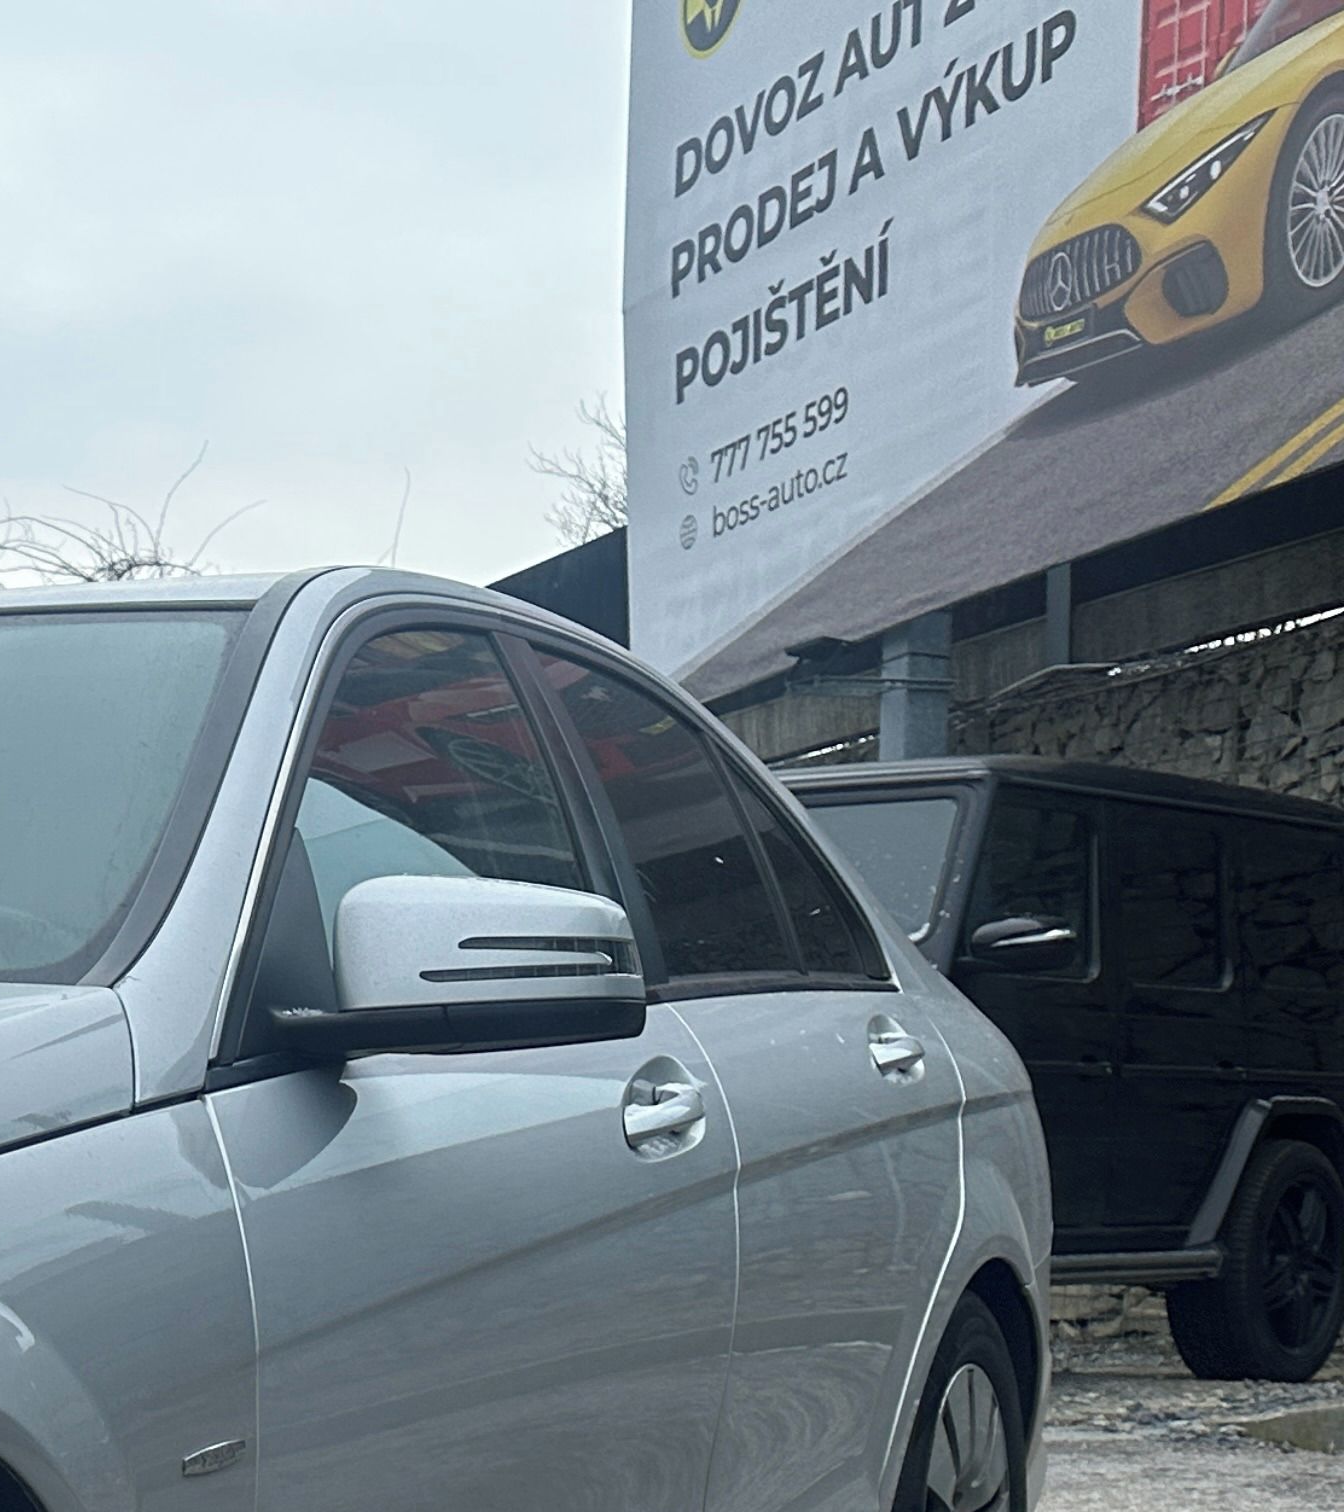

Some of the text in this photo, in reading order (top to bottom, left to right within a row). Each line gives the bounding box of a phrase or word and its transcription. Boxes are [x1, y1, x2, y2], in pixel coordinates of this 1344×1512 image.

[672, 9, 1076, 299] PRODEJ A VÝKUP
[675, 0, 922, 198] DOVOZ AUT
[675, 216, 895, 405] POJIŠTĚNÍ
[711, 386, 849, 483] 777 755 599
[713, 452, 849, 538] boss-auto.cz
